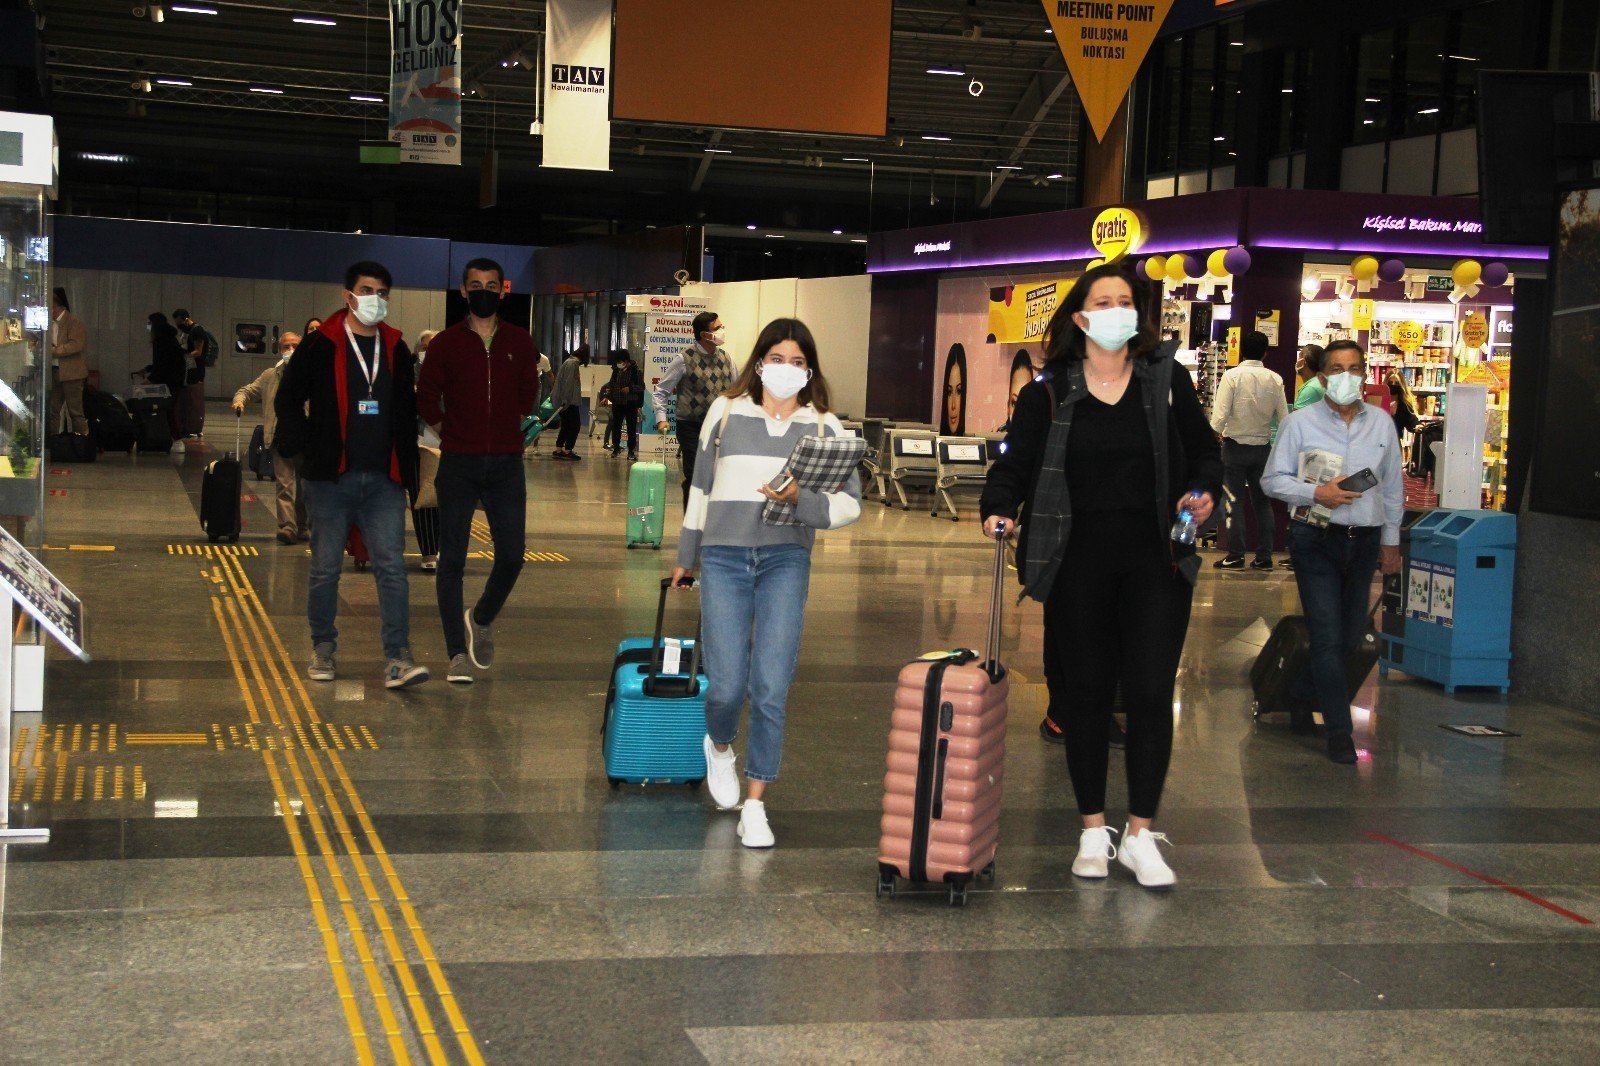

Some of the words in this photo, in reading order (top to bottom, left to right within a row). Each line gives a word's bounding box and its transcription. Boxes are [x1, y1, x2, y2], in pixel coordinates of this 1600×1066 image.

[1057, 1, 1113, 20] MEETING
[1117, 4, 1155, 22] POINT
[1081, 26, 1128, 42] BULUŞMA
[393, 44, 457, 74] GELDİNİZ
[1082, 45, 1125, 60] NOKTASI
[552, 64, 605, 86] TAV
[551, 83, 605, 94] Havalimanları
[1095, 212, 1128, 246] gratis
[1362, 215, 1407, 233] Kişisel
[1408, 218, 1452, 232] Bakım
[661, 297, 684, 309] ŞANİ
[653, 326, 680, 334] ALINAN
[1398, 331, 1419, 339] %50
